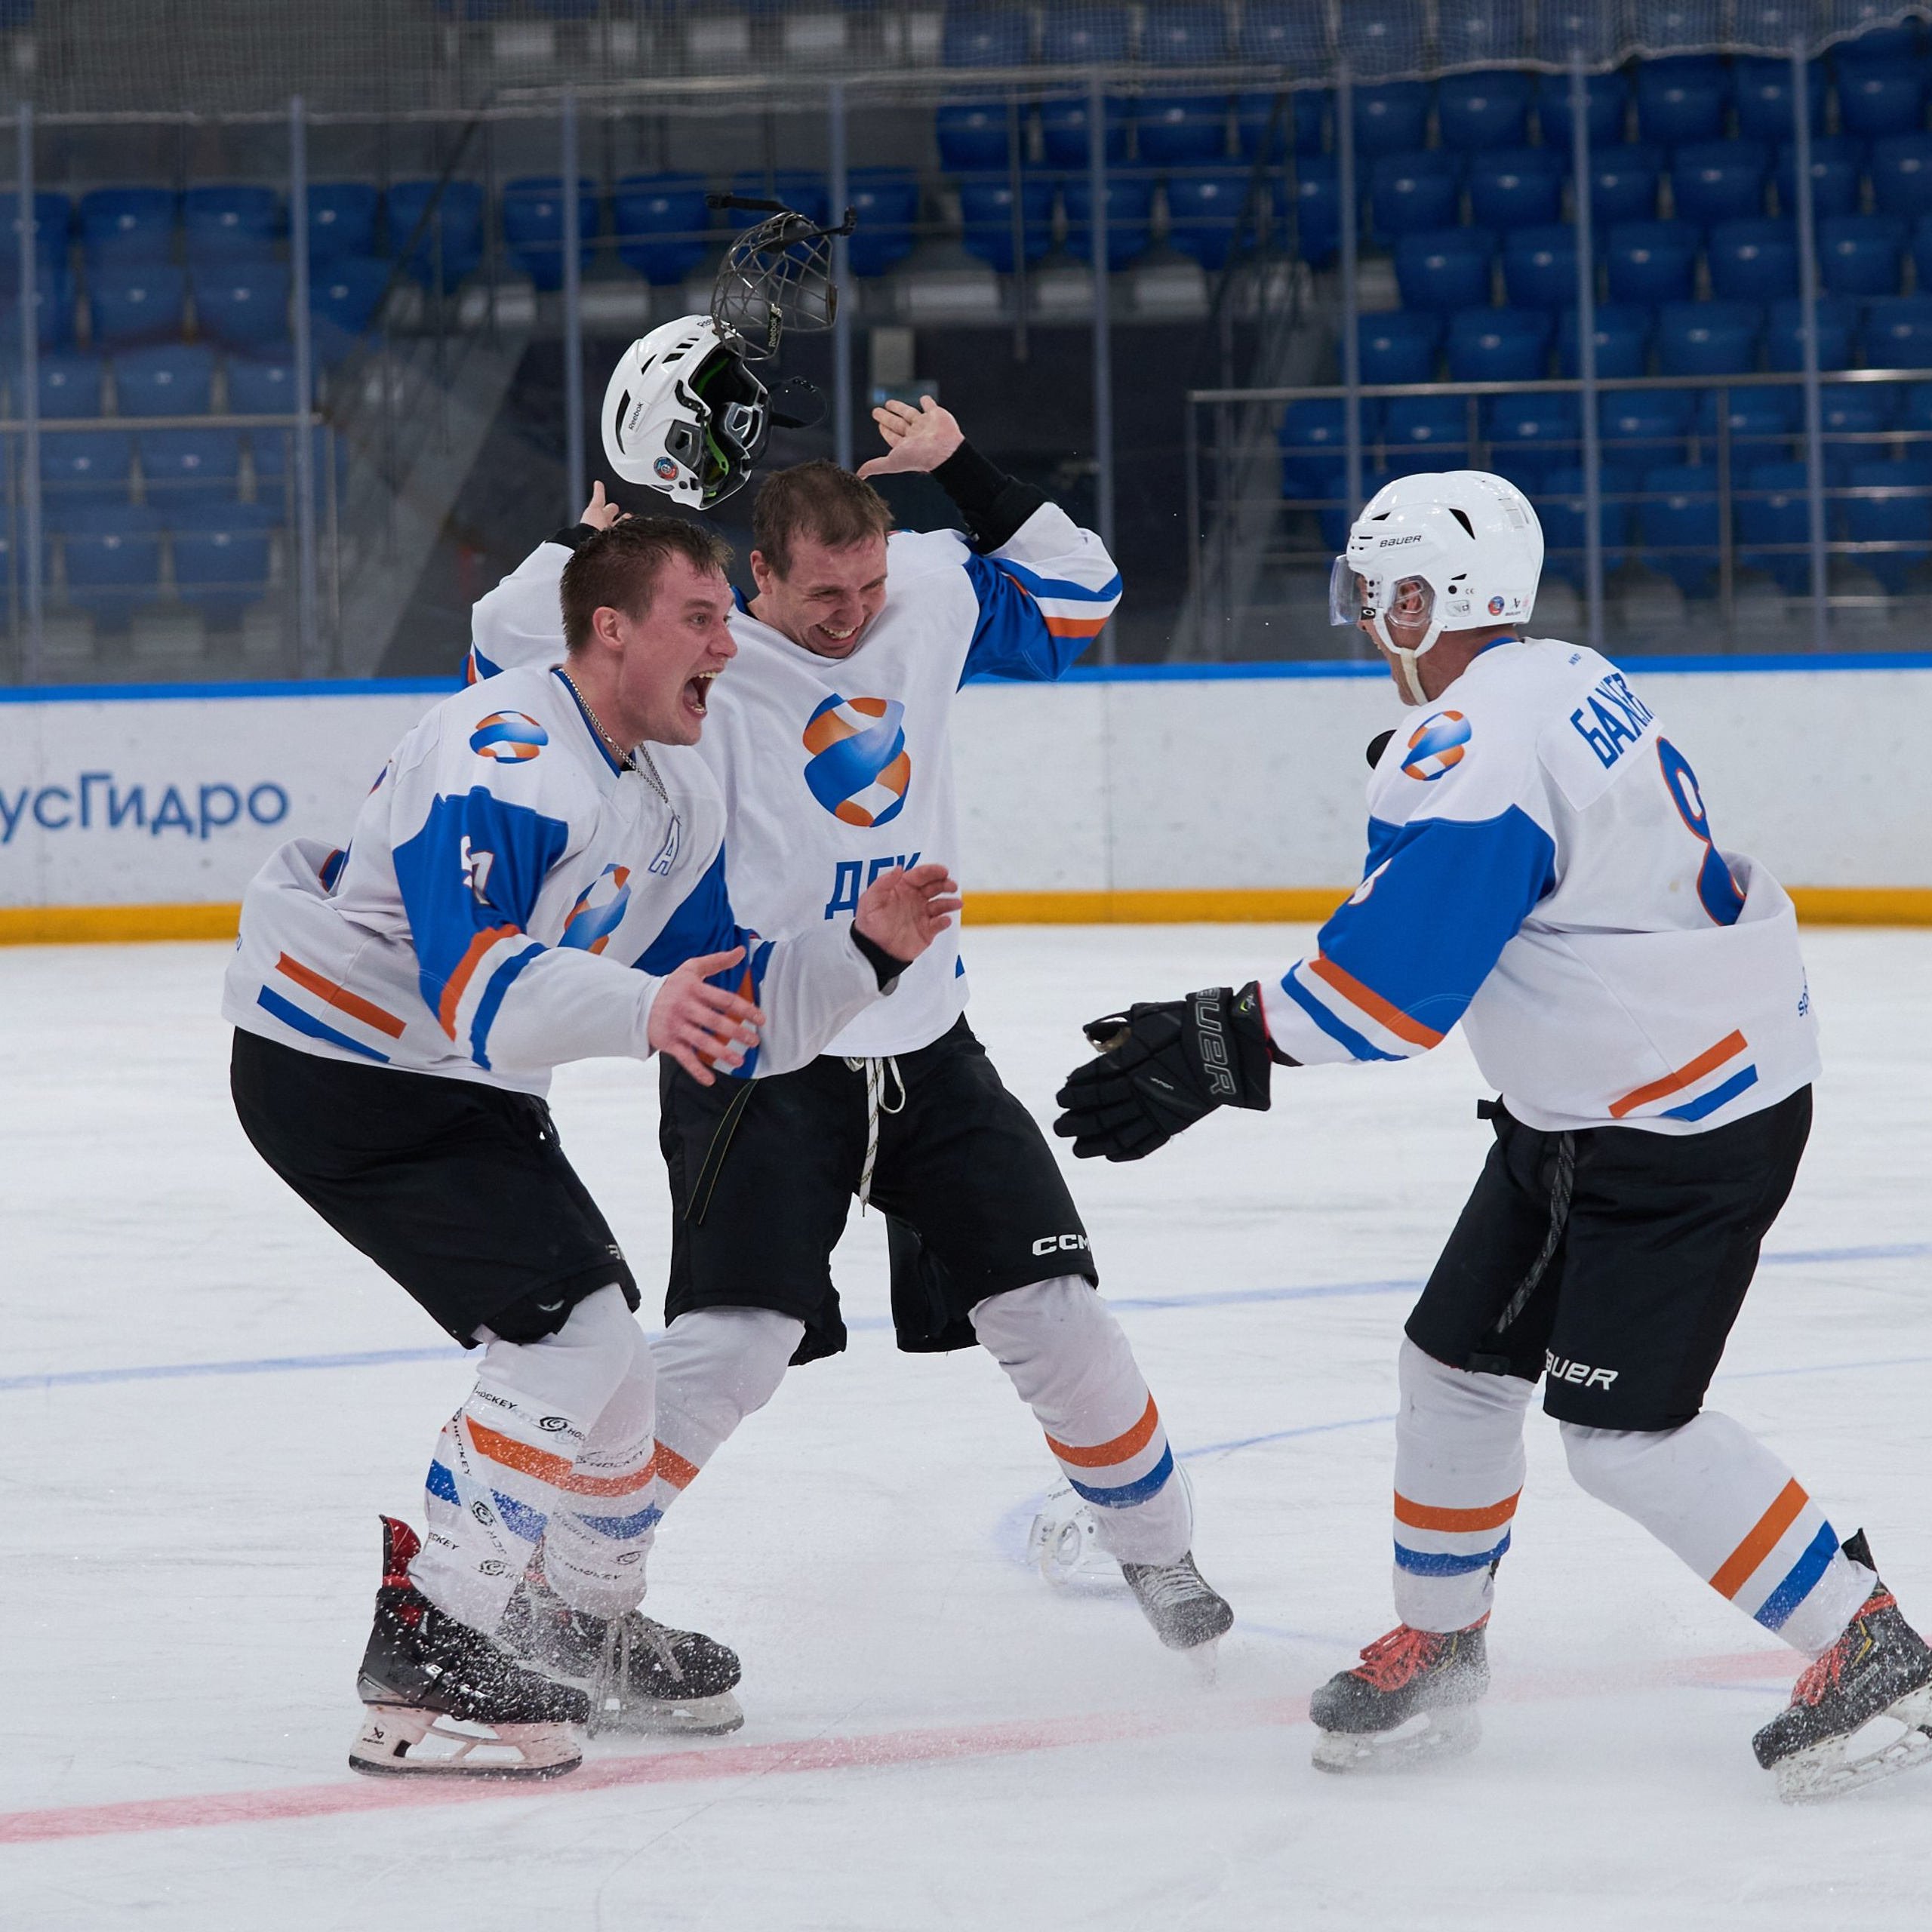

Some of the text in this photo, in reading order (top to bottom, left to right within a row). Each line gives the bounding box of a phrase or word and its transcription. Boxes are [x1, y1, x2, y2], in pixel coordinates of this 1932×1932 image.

[769, 317, 778, 347] Reebok
[629, 402, 644, 430] Reebok
[1380, 535, 1422, 548] BAUER
[1032, 1234, 1091, 1256] CCM
[1545, 1348, 1619, 1390] AUER
